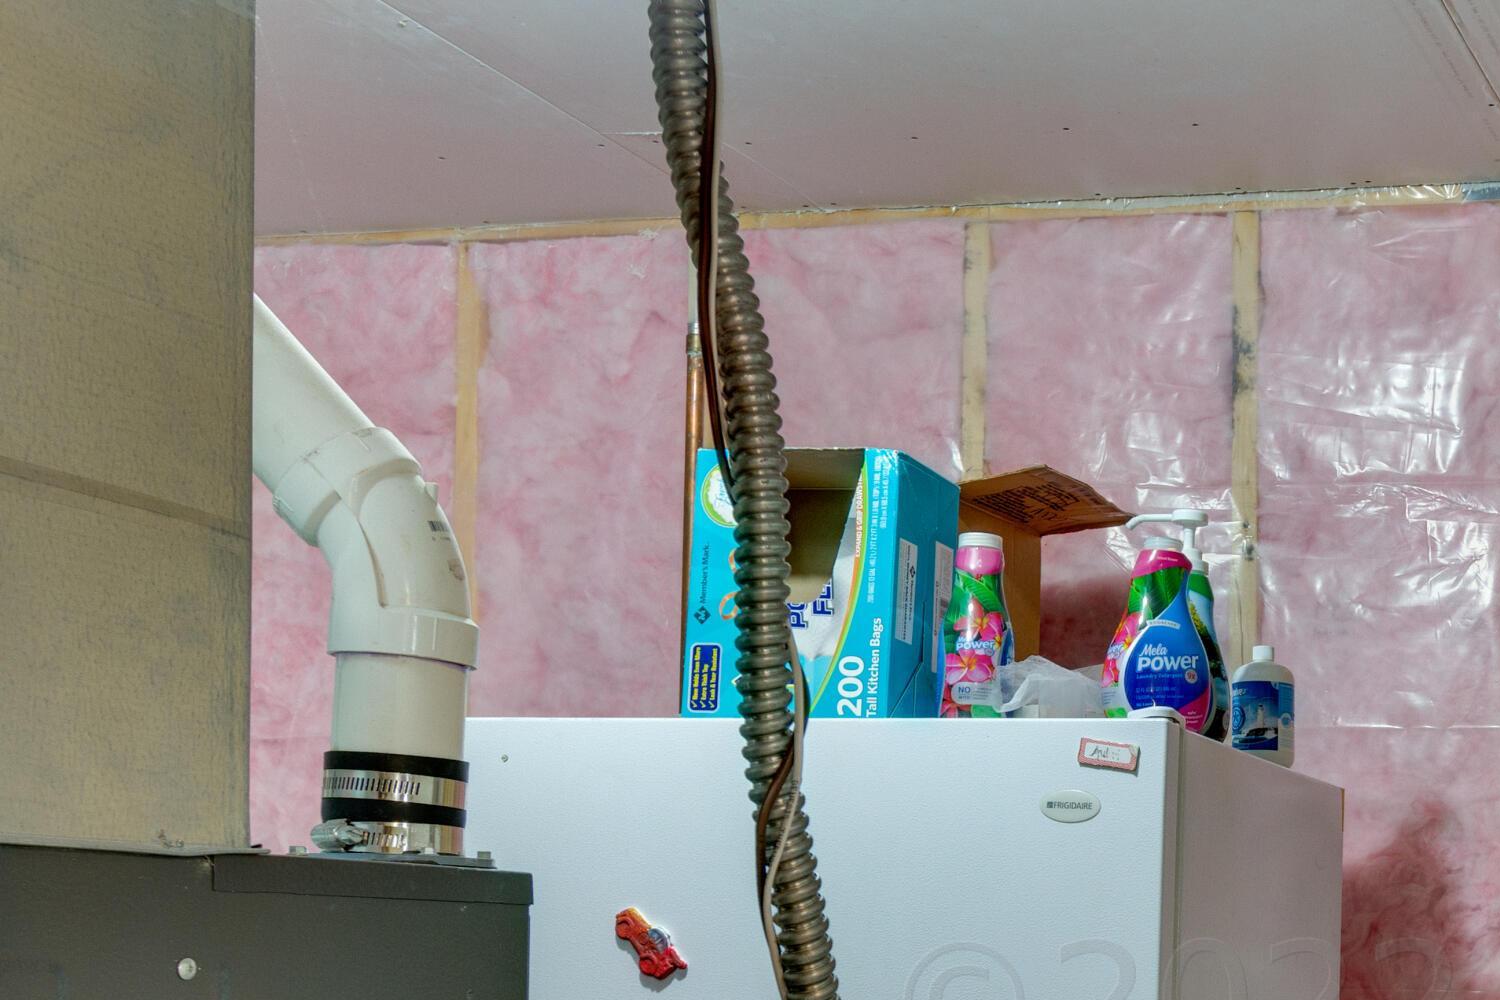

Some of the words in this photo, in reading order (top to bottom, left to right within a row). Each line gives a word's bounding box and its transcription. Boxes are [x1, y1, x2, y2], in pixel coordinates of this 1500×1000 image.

[699, 566, 709, 605] Member's
[870, 617, 884, 647] Bags
[1139, 643, 1168, 657] Mela
[837, 656, 864, 716] 200
[867, 649, 880, 694] Kitchen
[866, 697, 878, 717] Tall
[1053, 801, 1093, 810] FRIGIDAIRE
